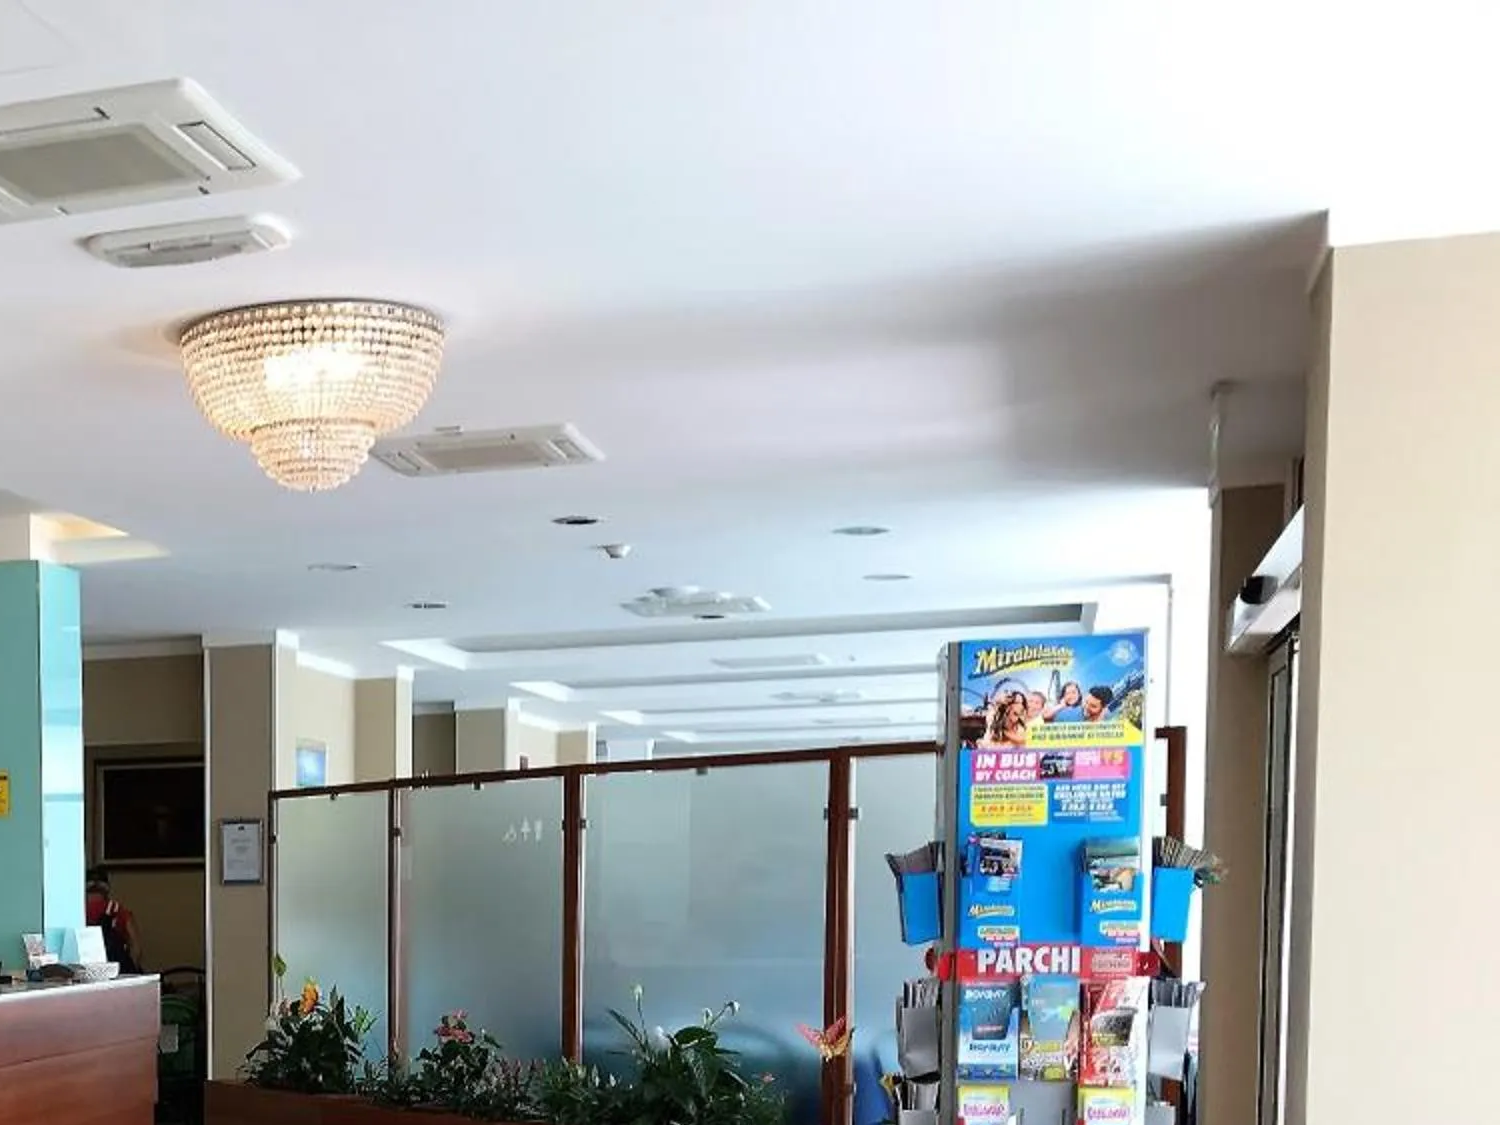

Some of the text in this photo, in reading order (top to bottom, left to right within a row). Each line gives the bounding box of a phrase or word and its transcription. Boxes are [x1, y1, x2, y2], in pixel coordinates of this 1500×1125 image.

[976, 752, 1037, 769] IN BUS
[975, 769, 1037, 782] BY COACH
[977, 945, 1081, 974] PARCHI
